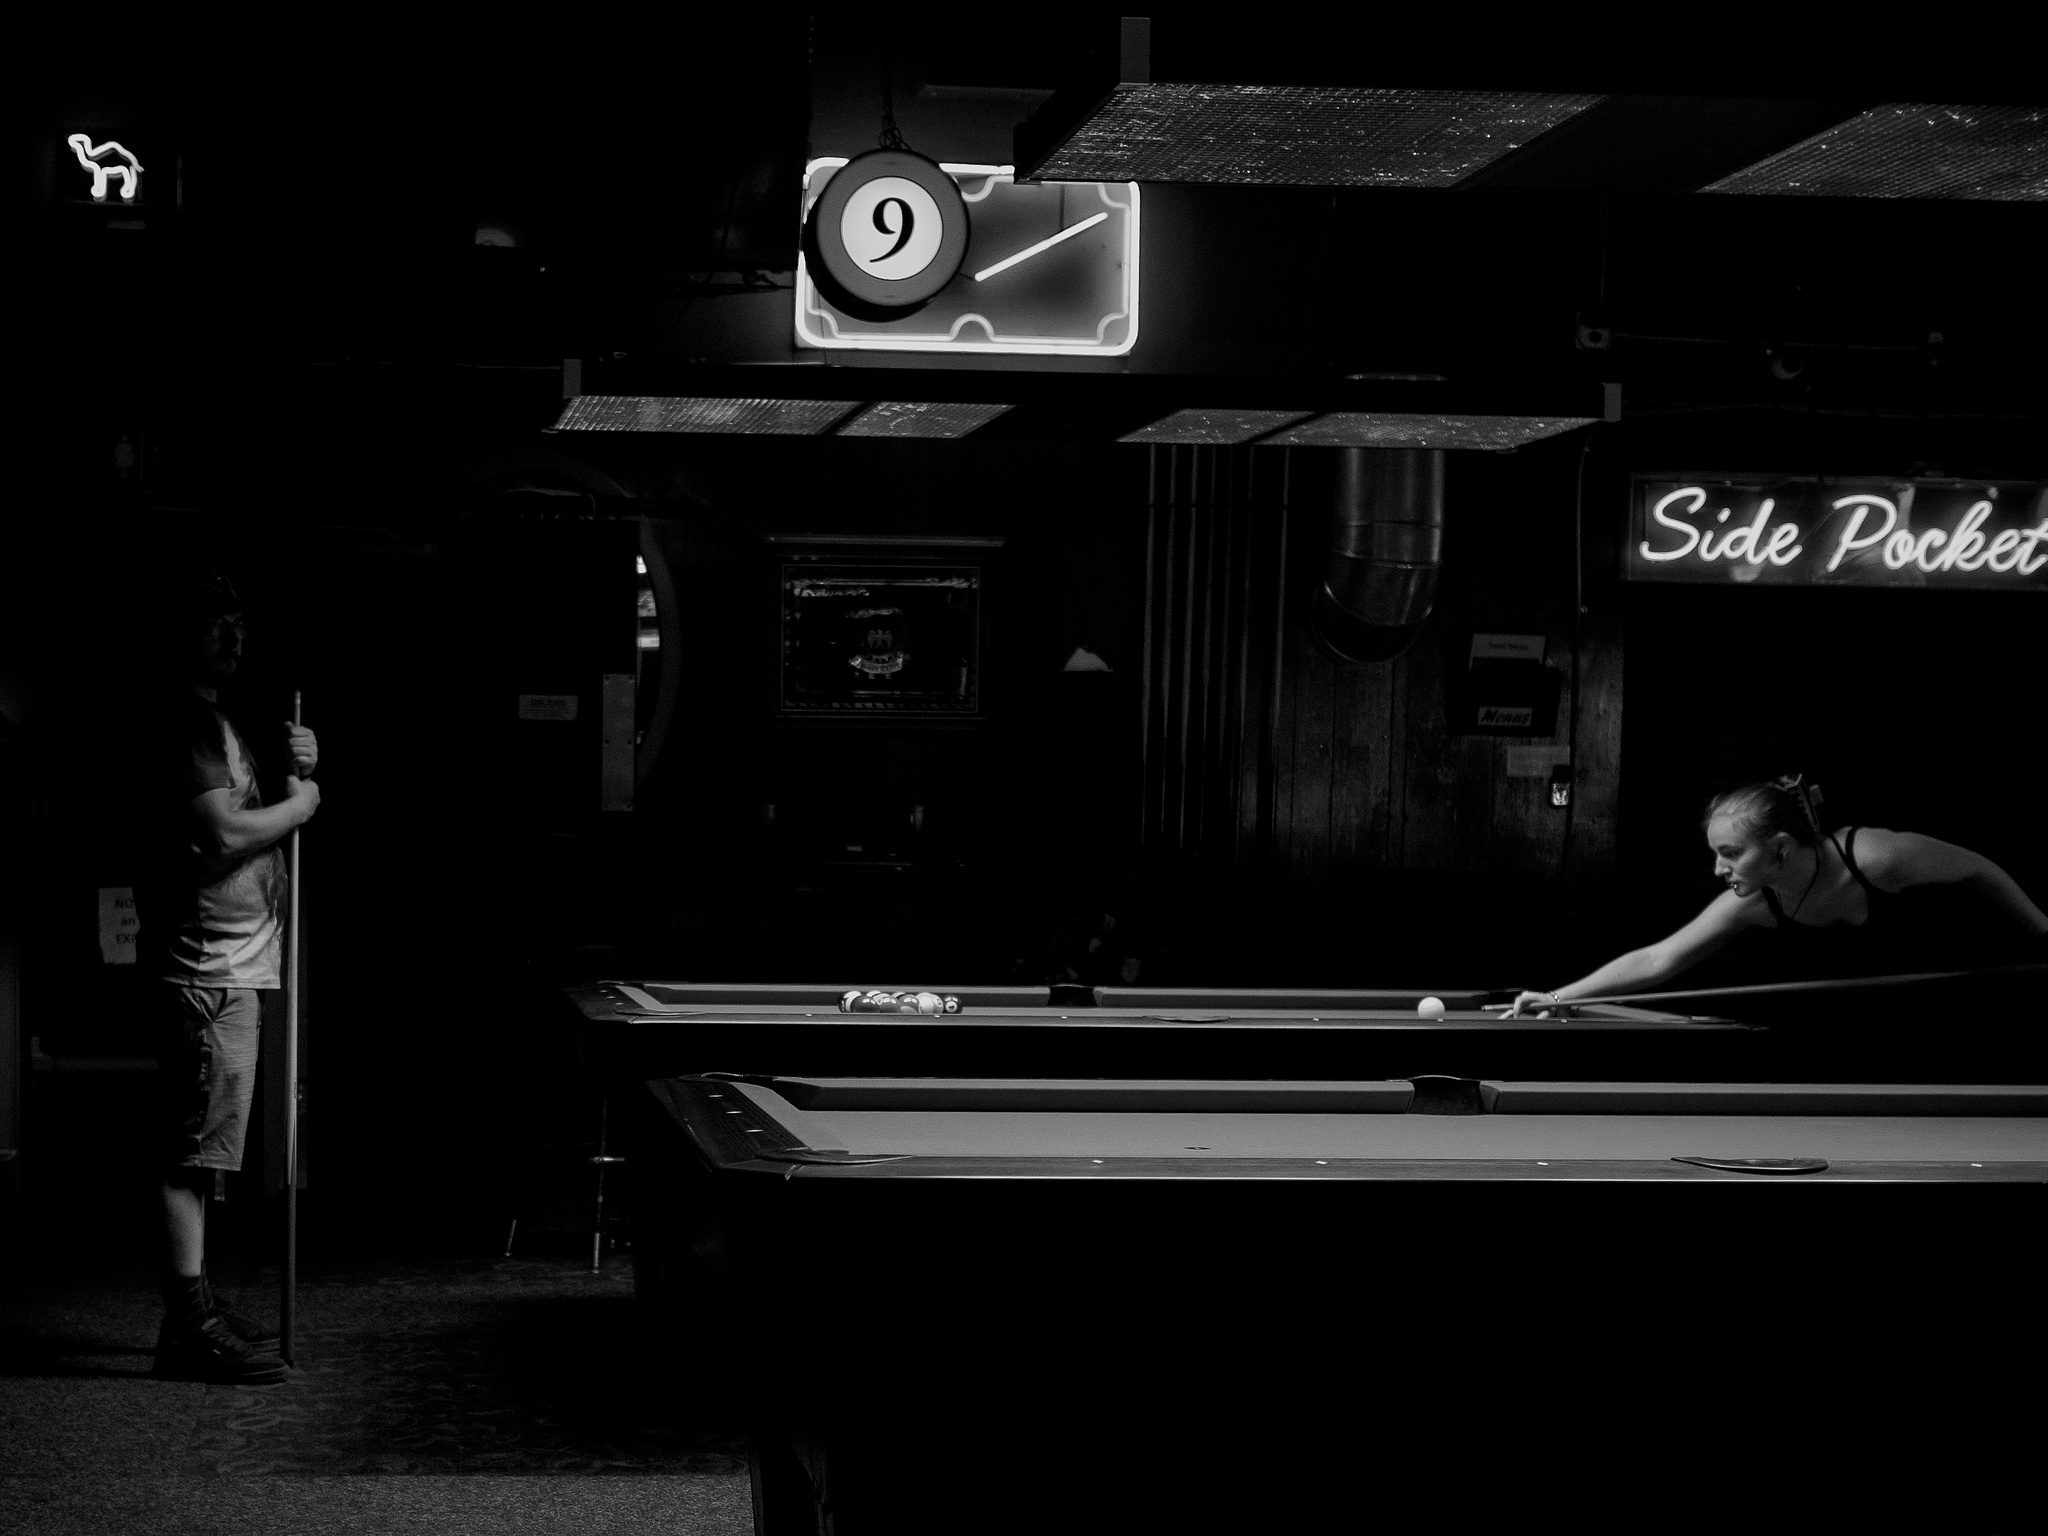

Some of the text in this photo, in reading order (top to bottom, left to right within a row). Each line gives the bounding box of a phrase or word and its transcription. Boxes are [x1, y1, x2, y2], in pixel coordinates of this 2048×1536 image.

[870, 197, 914, 262] 9
[1639, 486, 2048, 576] Side Pocket
[1481, 709, 1530, 724] Menus
